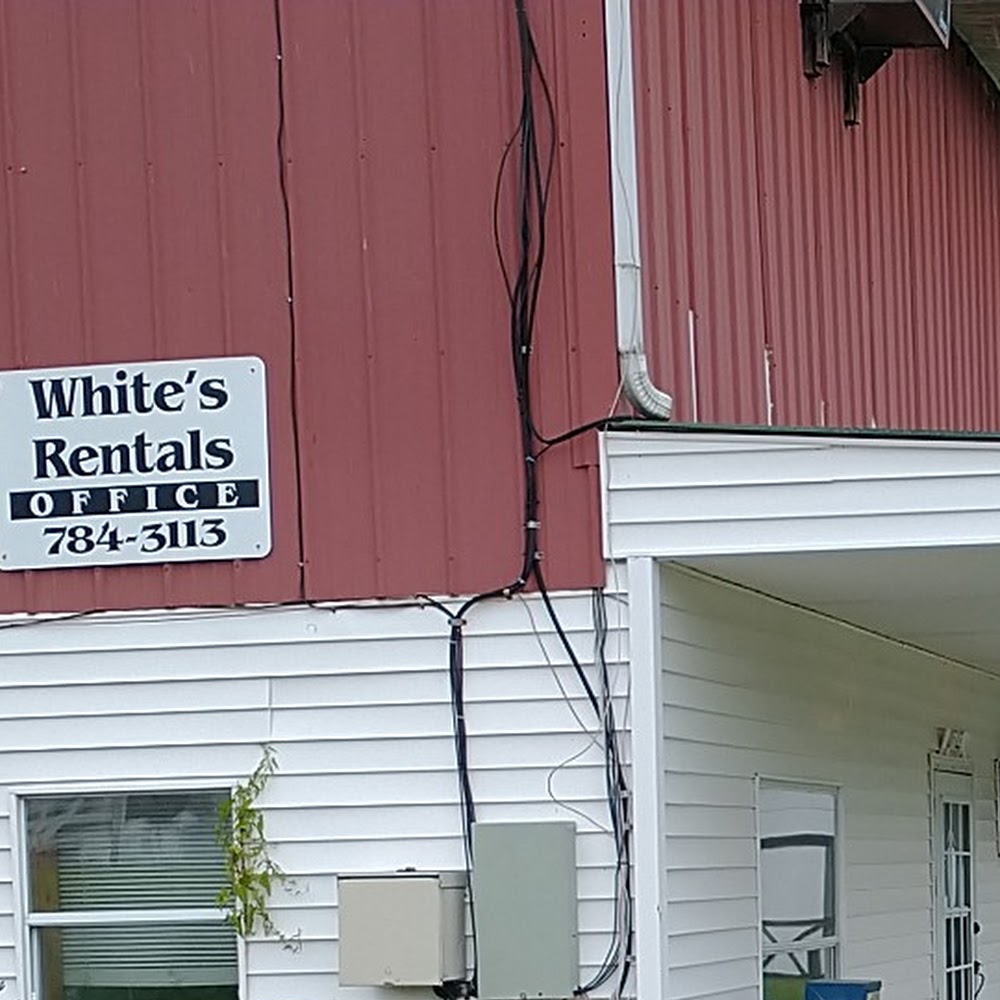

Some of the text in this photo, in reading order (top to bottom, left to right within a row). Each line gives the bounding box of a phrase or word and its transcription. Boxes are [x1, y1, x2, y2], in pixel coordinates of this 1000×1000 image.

[28, 370, 229, 420] White's
[32, 430, 235, 479] Rentals
[29, 482, 240, 518] OFFICE
[43, 519, 228, 555] 784-3113
